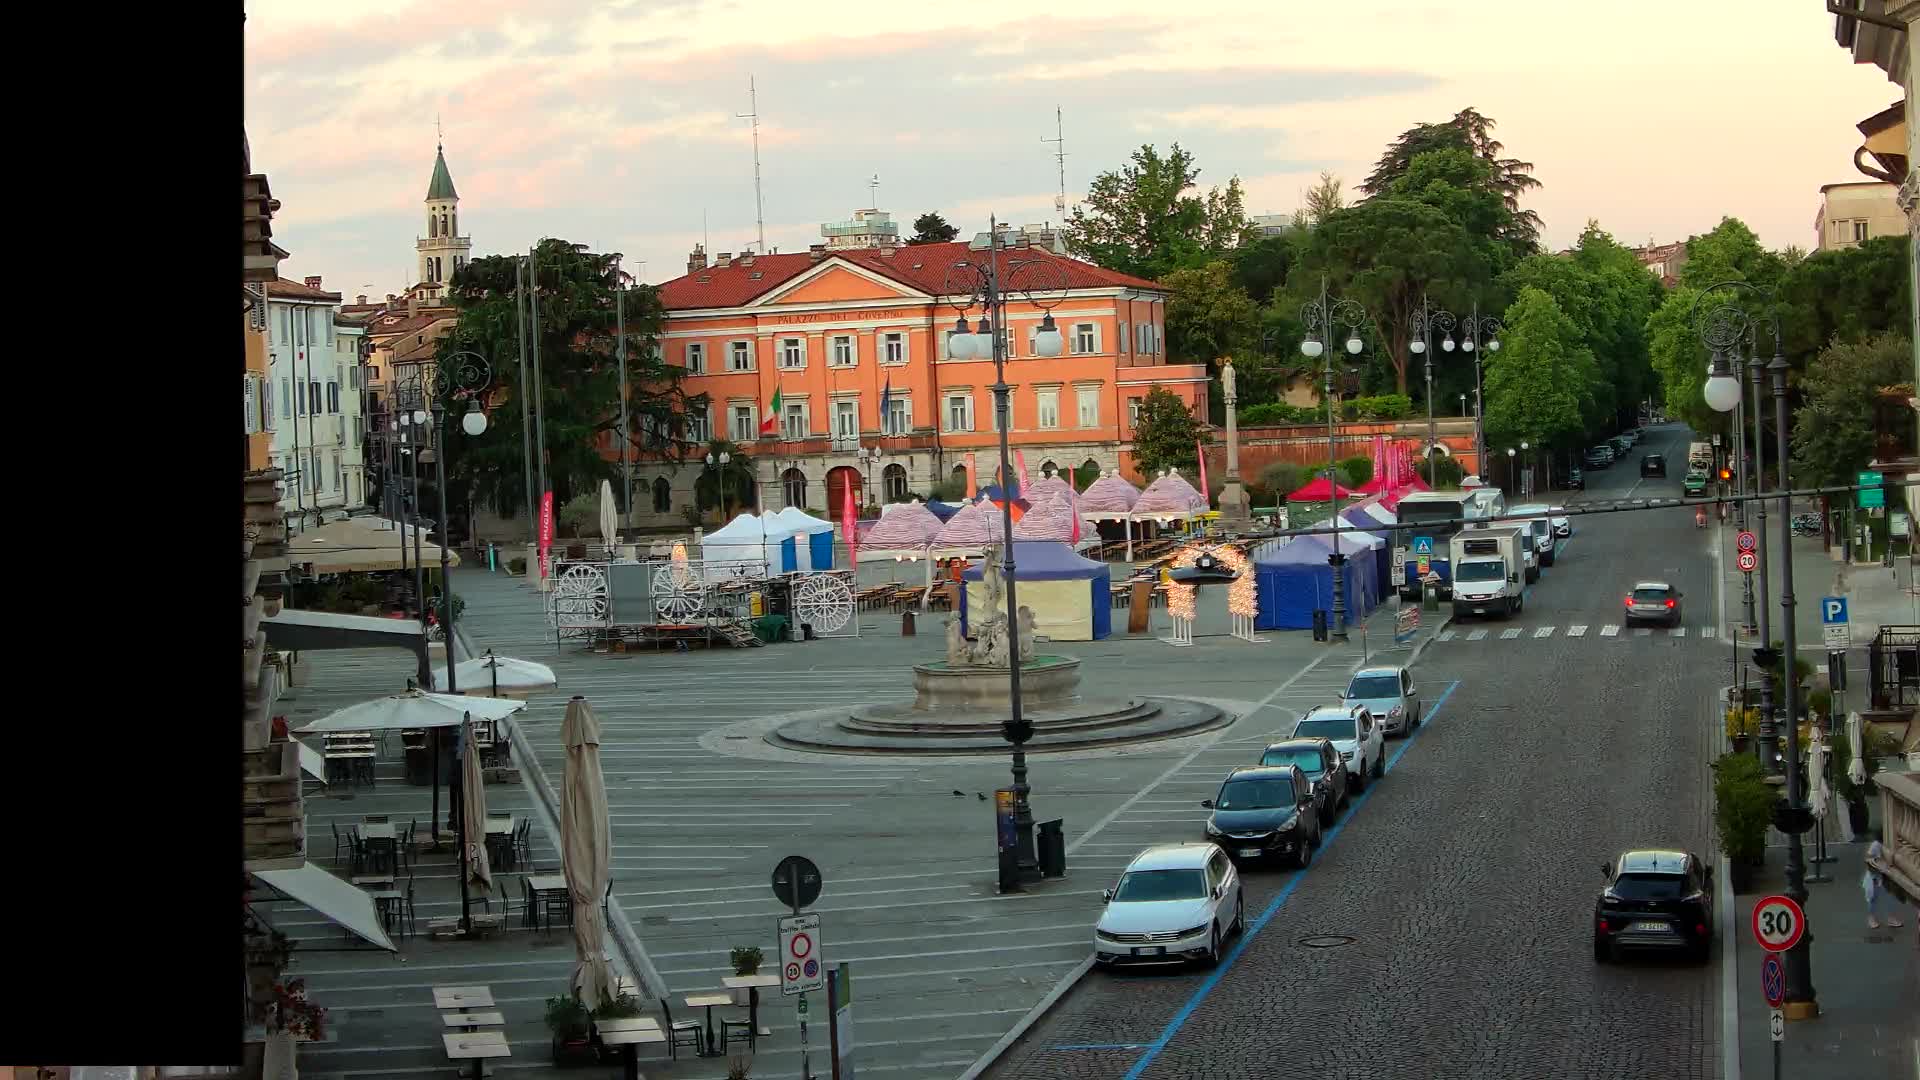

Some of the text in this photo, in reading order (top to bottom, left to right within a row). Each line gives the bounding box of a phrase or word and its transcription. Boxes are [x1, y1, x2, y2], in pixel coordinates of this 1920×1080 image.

[858, 310, 904, 321] GOVERNO
[1742, 556, 1753, 566] 20
[1827, 601, 1843, 621] P
[1762, 910, 1792, 936] 30
